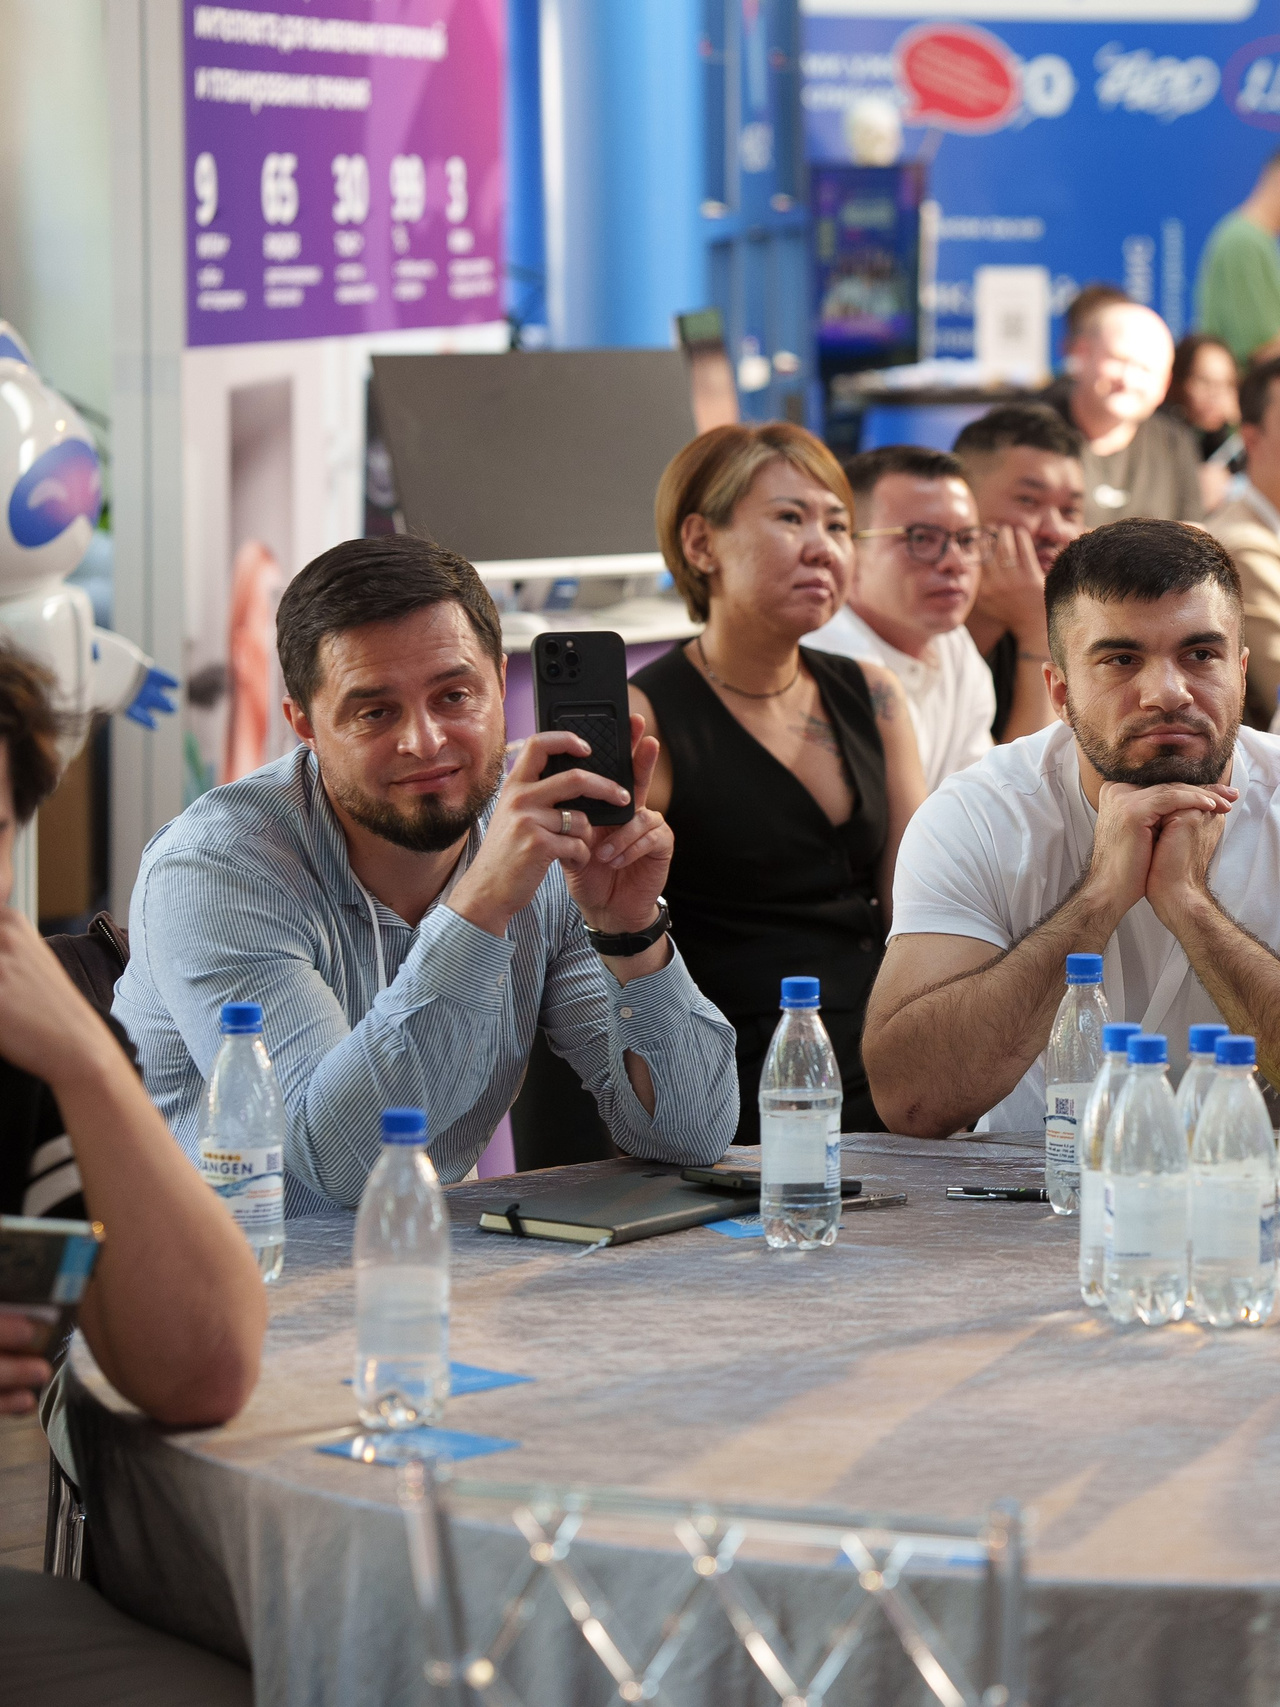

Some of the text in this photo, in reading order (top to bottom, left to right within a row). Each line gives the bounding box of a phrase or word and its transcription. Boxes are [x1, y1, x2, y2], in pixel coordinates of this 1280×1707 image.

[195, 152, 218, 227] 9
[261, 152, 299, 225] 65
[332, 153, 370, 225] 30
[445, 155, 468, 224] 3
